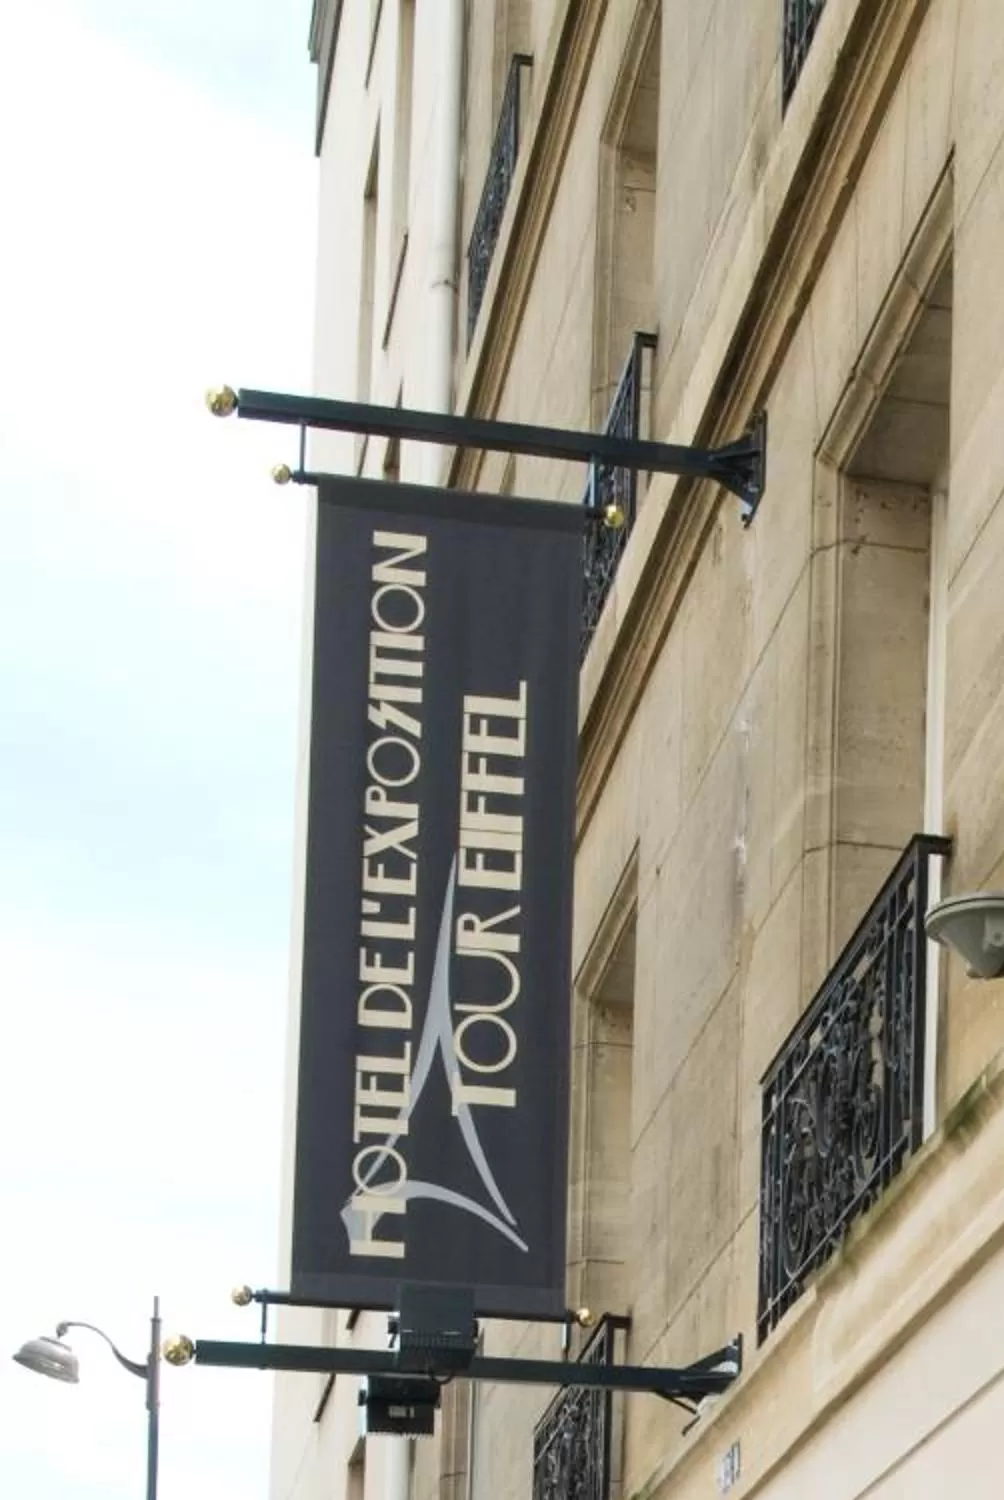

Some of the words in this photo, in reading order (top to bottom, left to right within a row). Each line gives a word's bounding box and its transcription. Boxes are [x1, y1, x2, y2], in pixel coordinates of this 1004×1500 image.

[360, 529, 428, 941] L'EXPOSITION
[457, 679, 528, 891] EIFFEL
[357, 946, 415, 1030] DE
[451, 905, 521, 1118] TOUR
[349, 1040, 412, 1260] HOTEL
